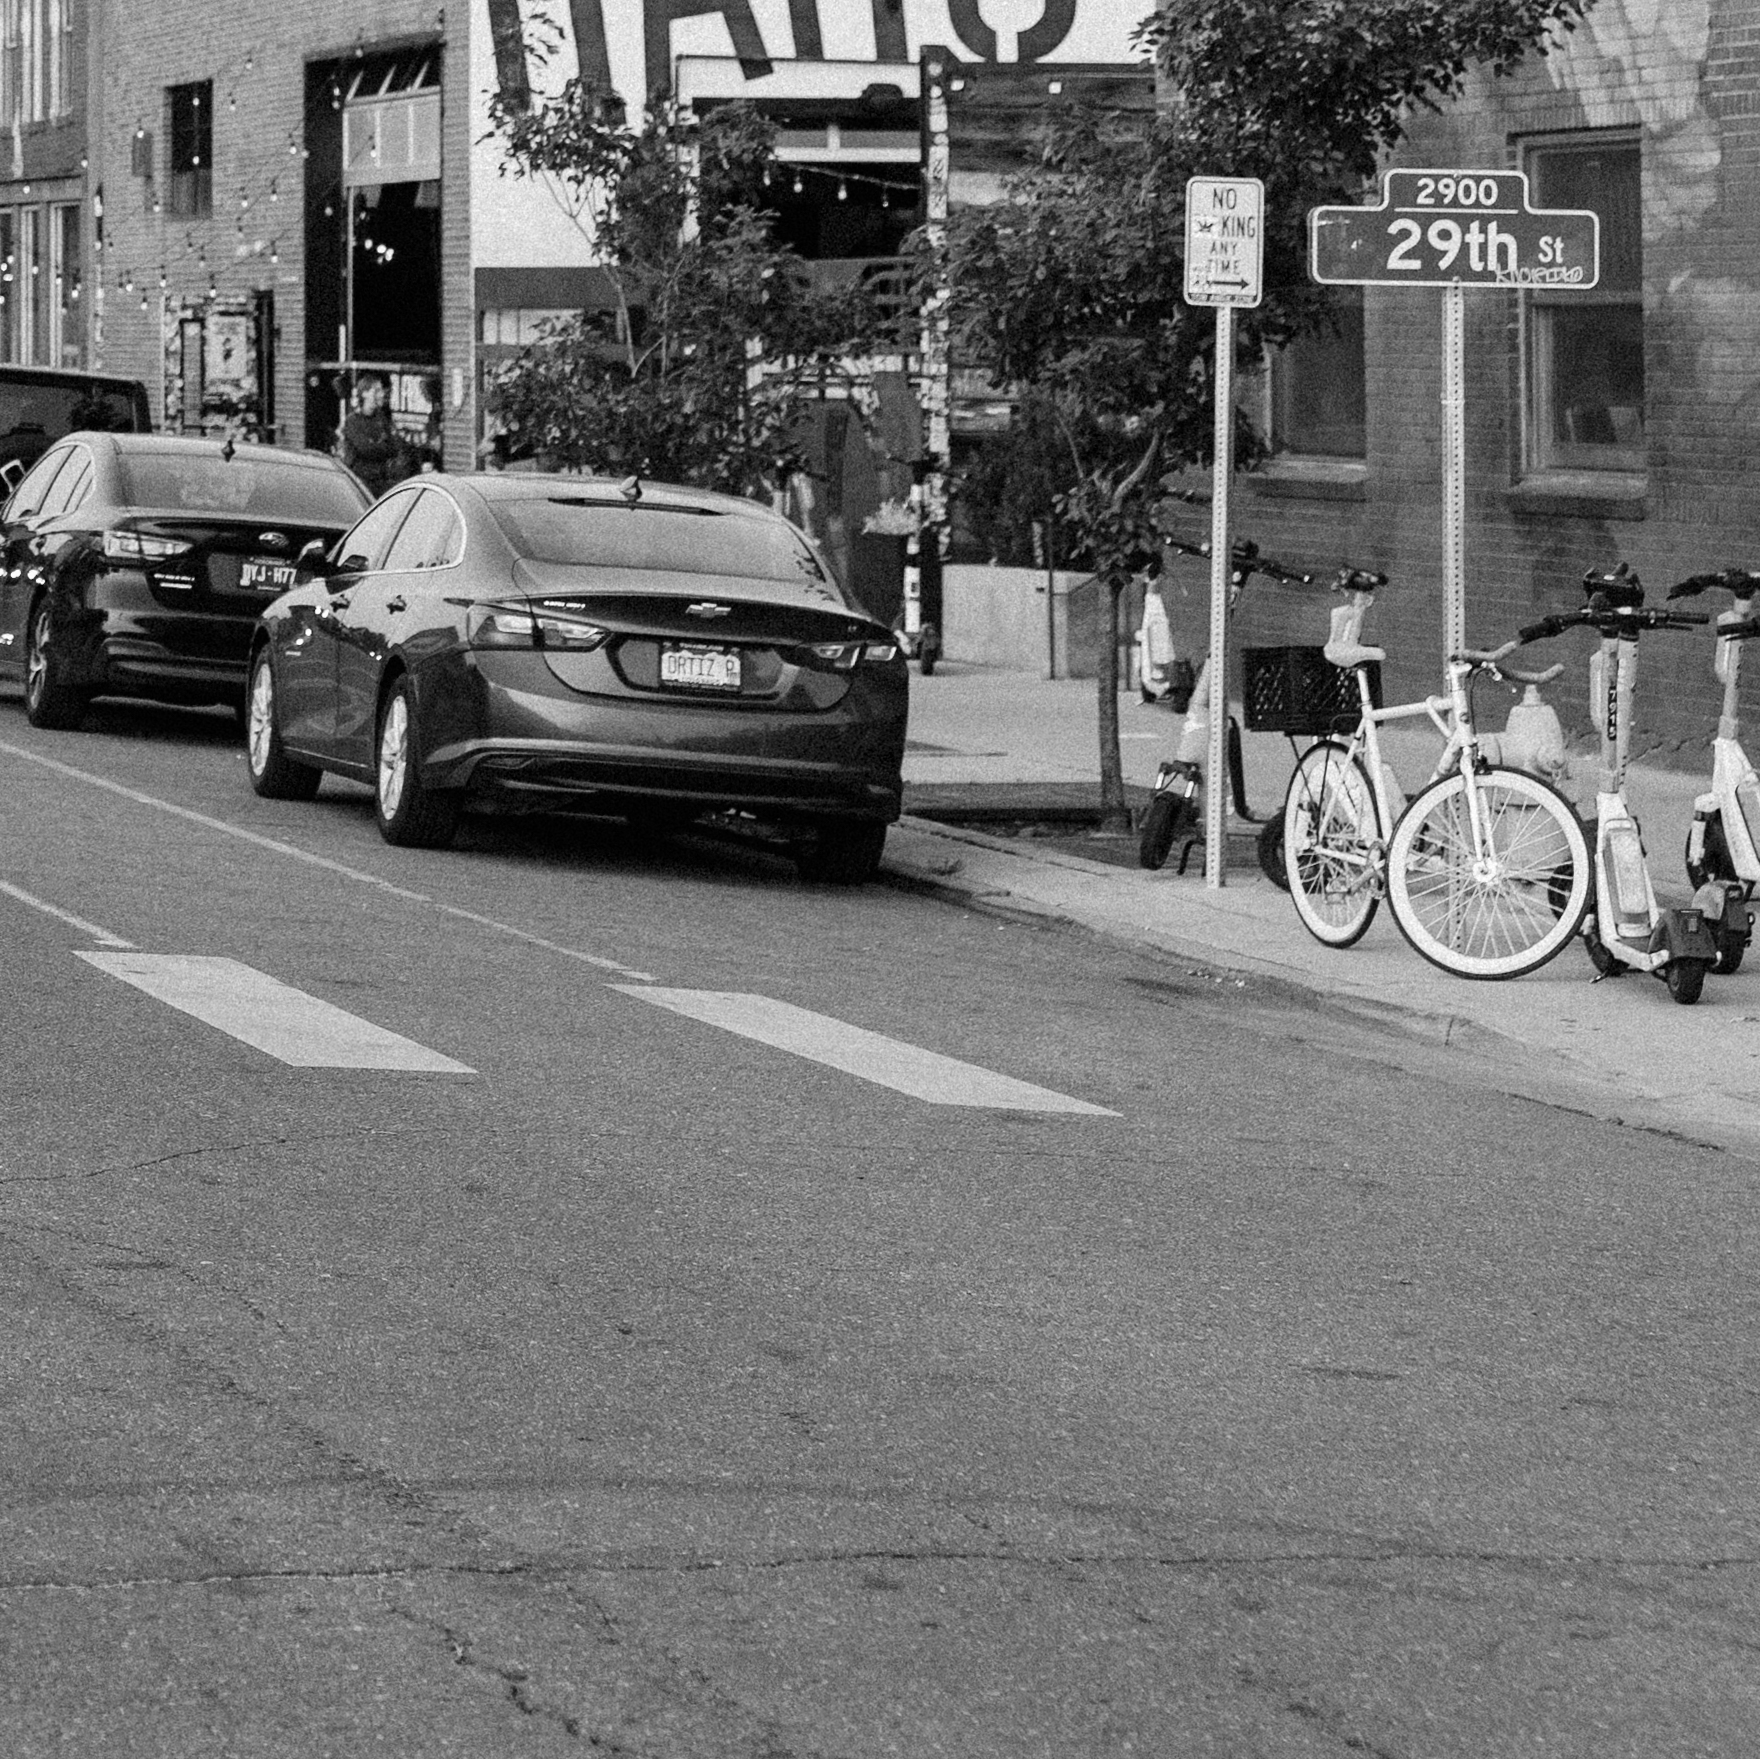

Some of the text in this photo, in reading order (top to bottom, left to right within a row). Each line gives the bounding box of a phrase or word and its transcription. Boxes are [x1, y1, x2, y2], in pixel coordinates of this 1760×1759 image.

[1212, 188, 1237, 210] NO
[1416, 177, 1498, 206] 2900
[1209, 241, 1238, 256] ANY
[1386, 217, 1564, 272] 29th St
[1206, 259, 1239, 275] TIME
[1608, 690, 1617, 738] 7915
